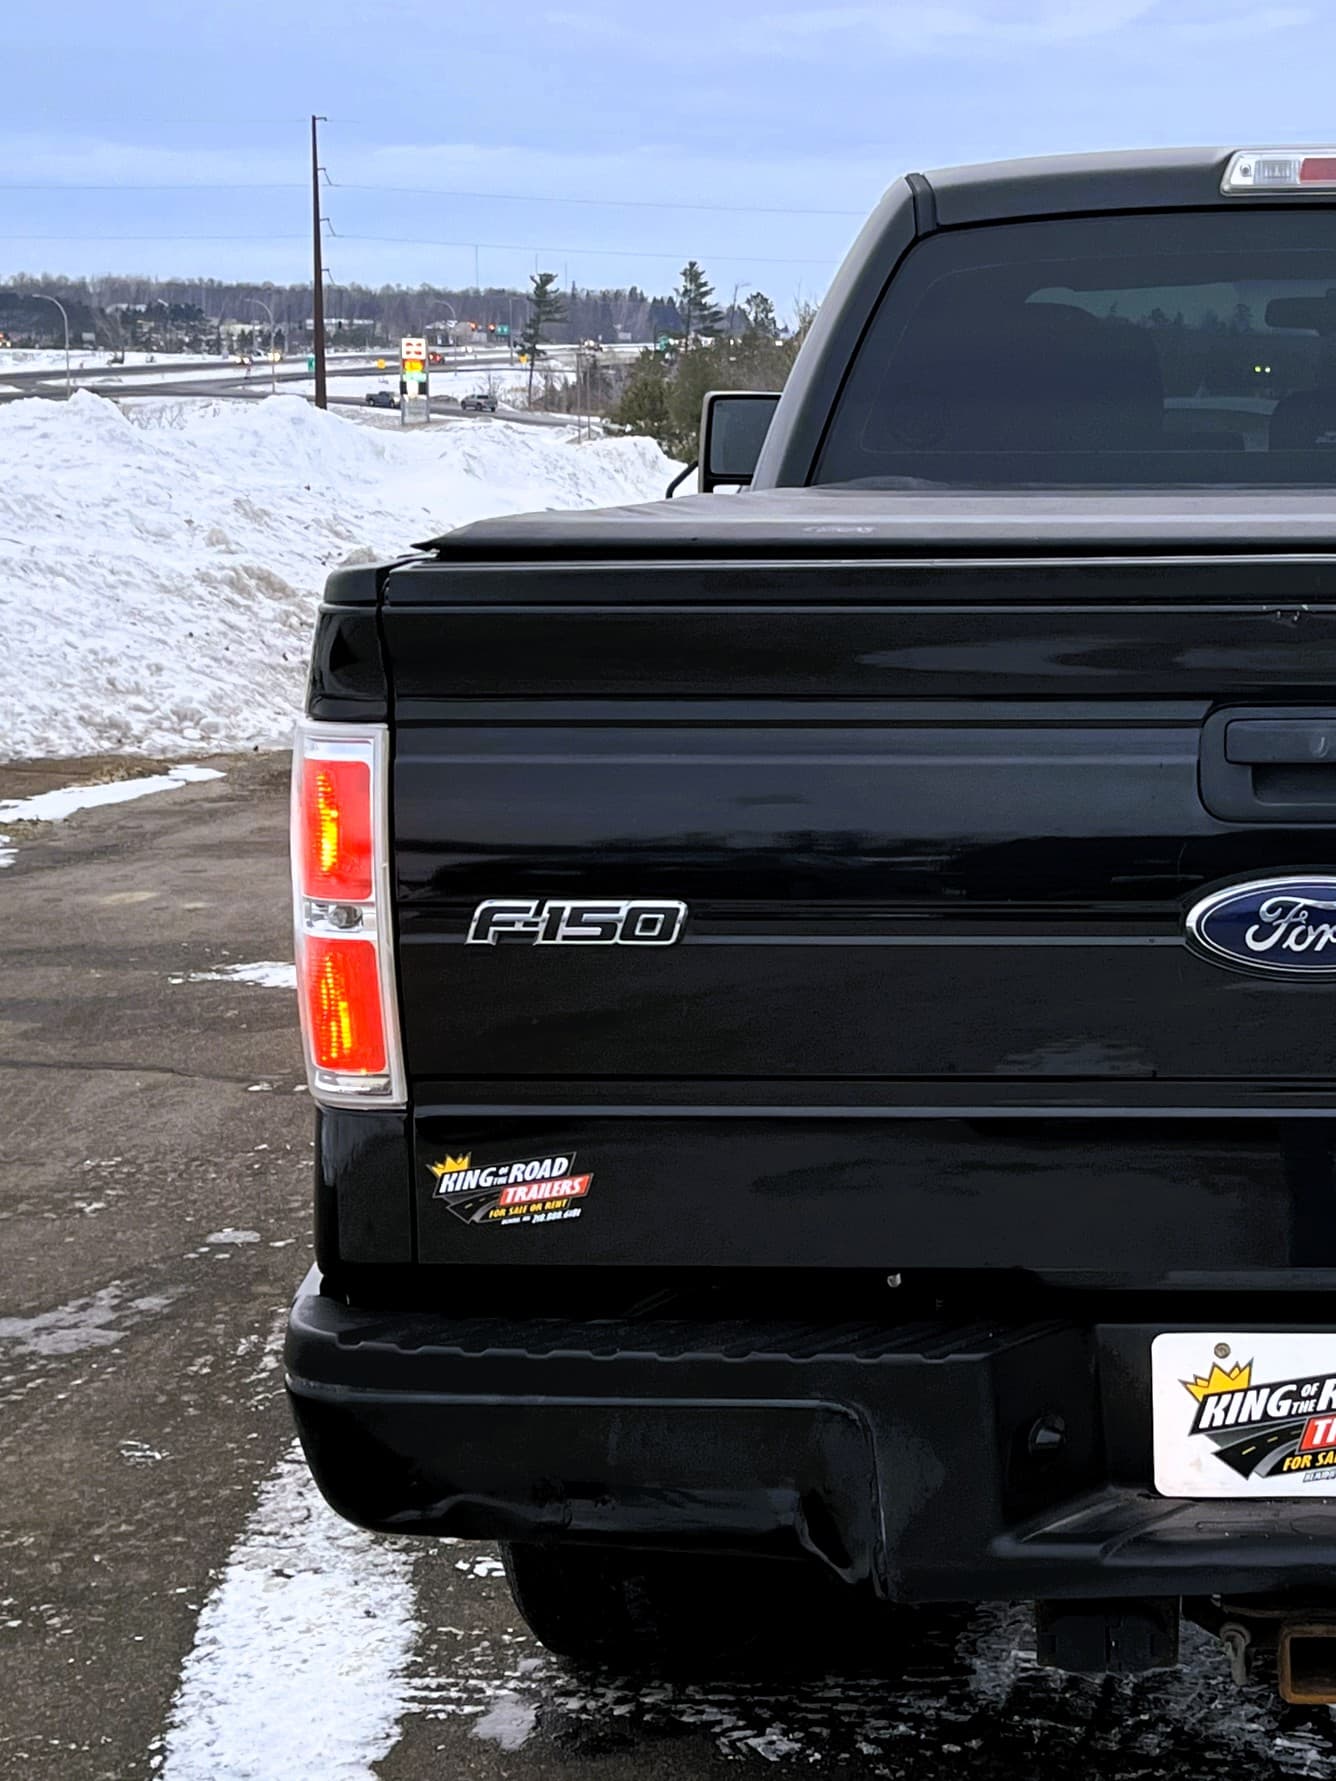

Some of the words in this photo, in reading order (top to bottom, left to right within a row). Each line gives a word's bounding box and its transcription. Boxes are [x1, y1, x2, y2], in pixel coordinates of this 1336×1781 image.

[464, 900, 688, 946] F-150
[439, 1167, 497, 1193] KING
[508, 1157, 569, 1183] ROAD
[504, 1177, 583, 1203] TRAILERS
[1301, 1382, 1320, 1398] OF
[1198, 1384, 1298, 1429] KING
[1291, 1399, 1317, 1415] THE
[1282, 1454, 1313, 1472] FOR
